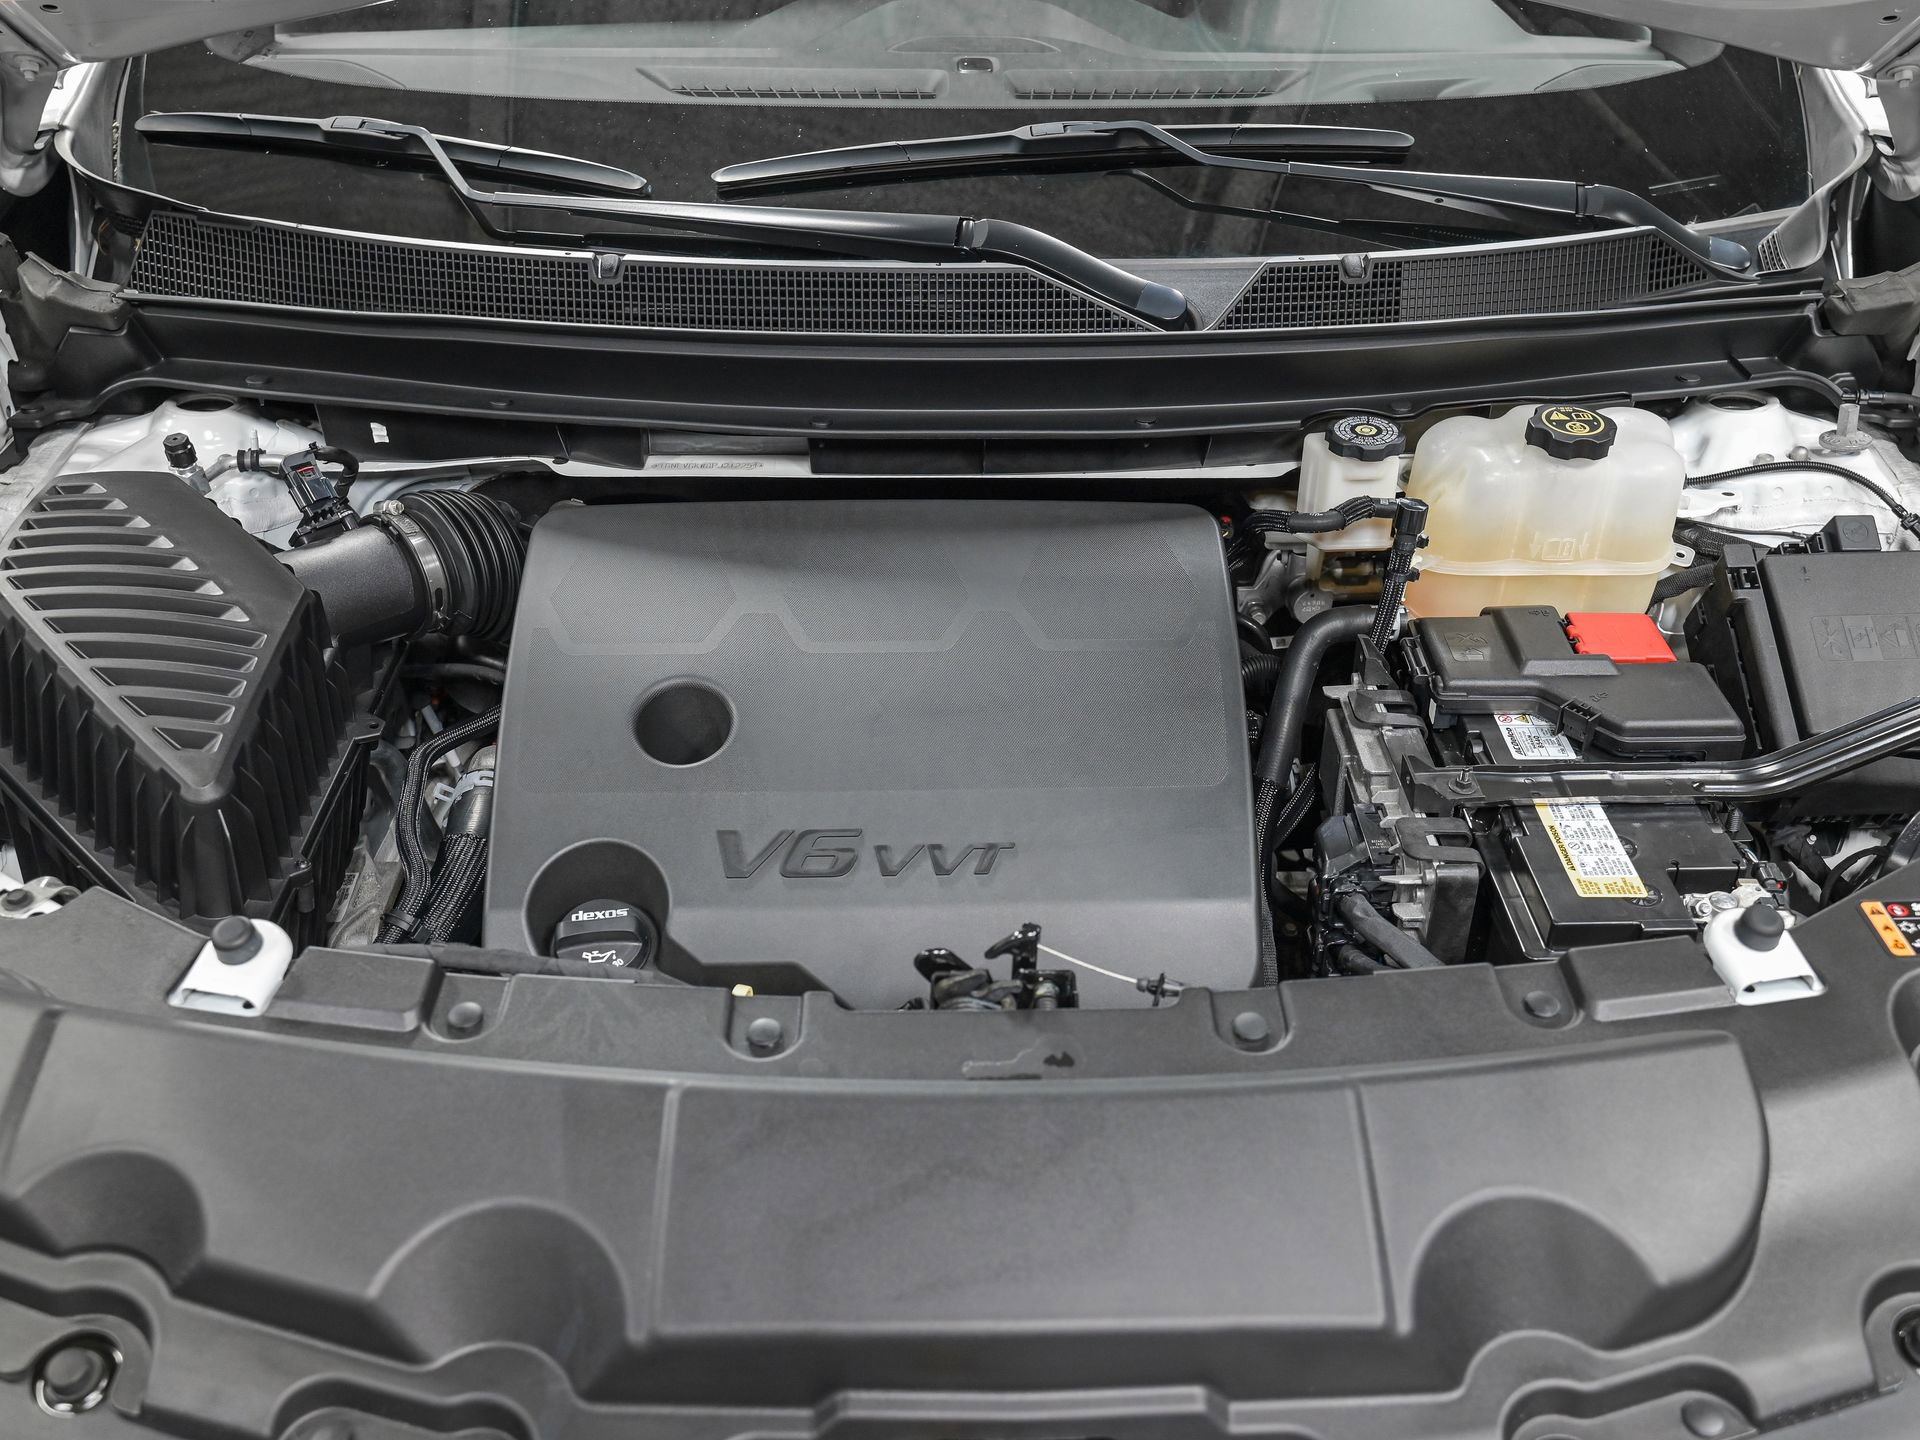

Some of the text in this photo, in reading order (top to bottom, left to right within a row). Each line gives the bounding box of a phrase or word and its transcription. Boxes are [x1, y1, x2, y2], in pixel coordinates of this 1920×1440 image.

[1506, 727, 1523, 755] ACDelco
[716, 828, 1016, 879] V6 VVT
[1548, 825, 1573, 866] DANGER POISON
[571, 908, 630, 922] dexos
